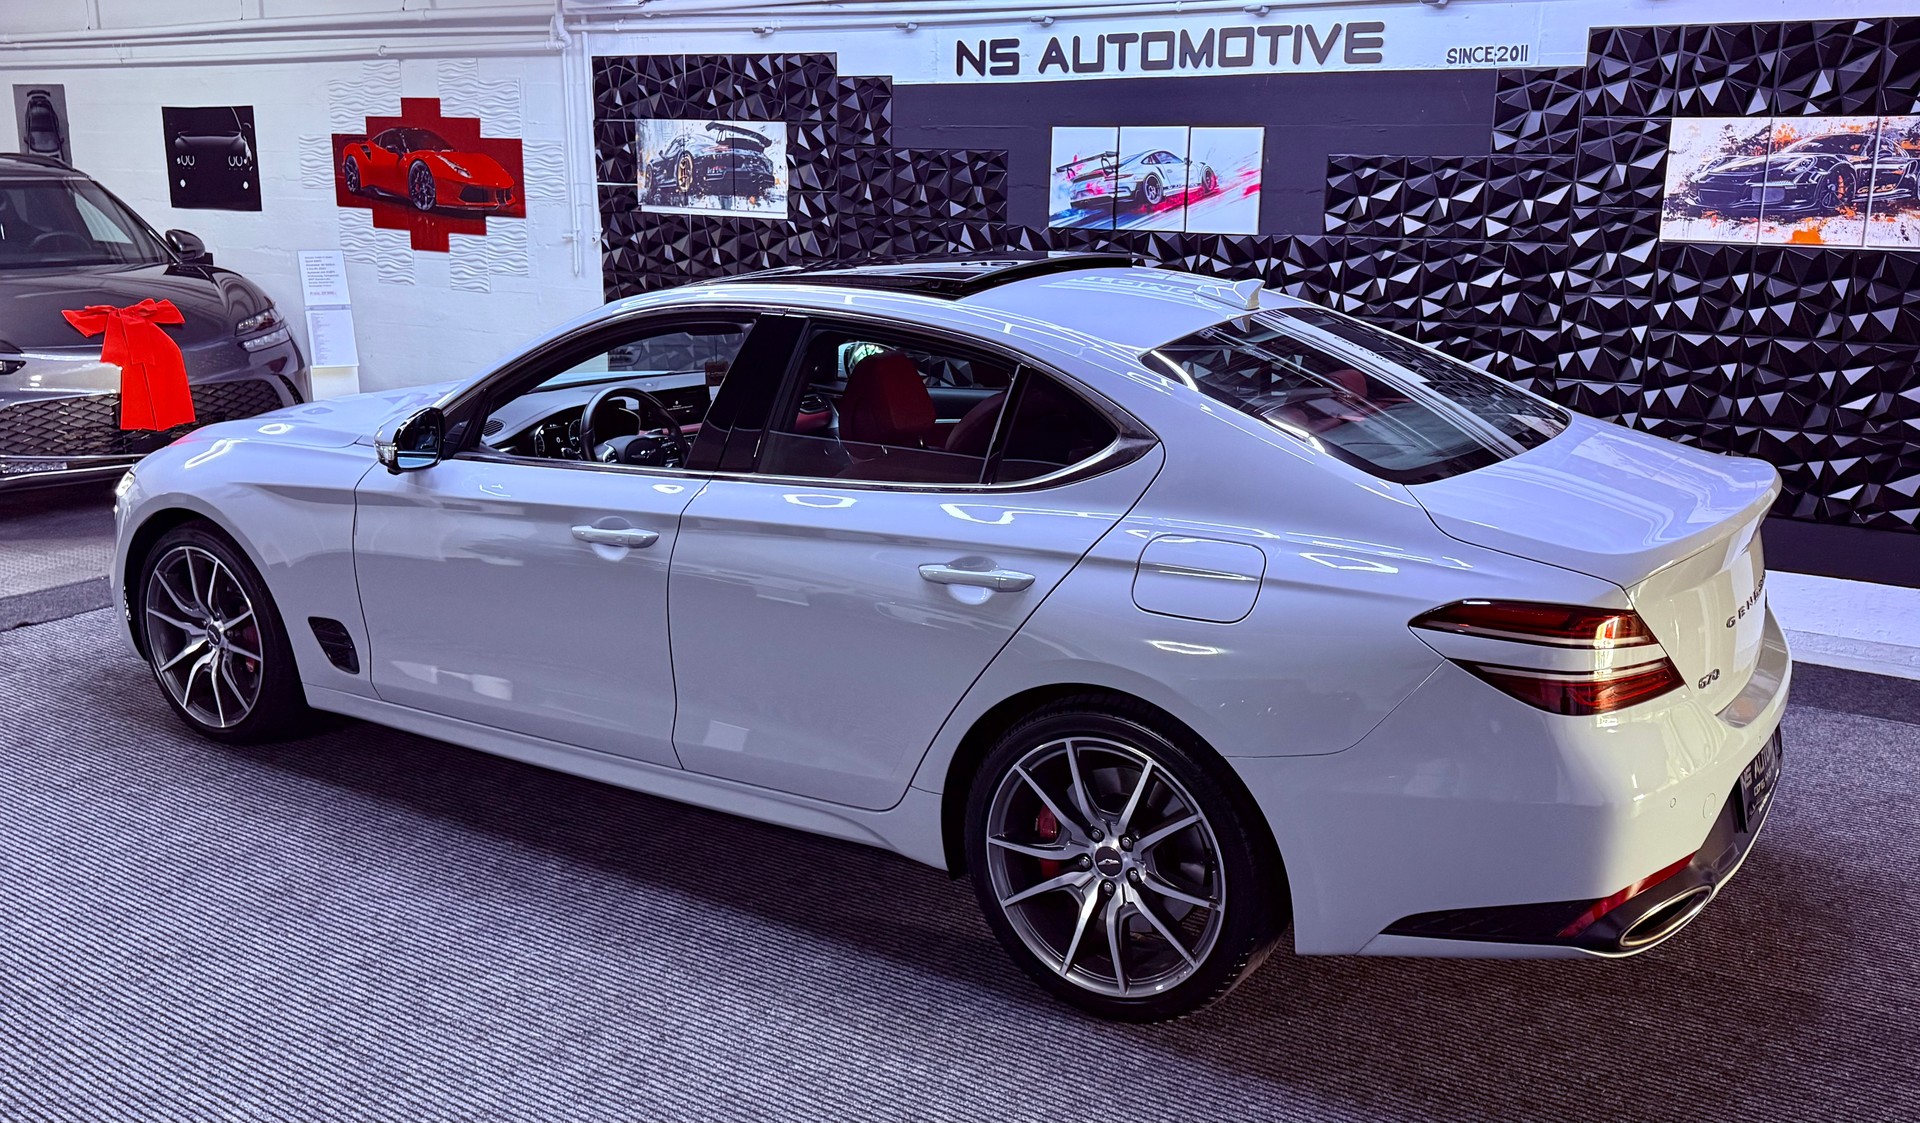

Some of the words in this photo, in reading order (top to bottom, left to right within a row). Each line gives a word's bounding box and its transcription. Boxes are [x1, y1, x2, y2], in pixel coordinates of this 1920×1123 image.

[956, 39, 1020, 77] NS
[1038, 21, 1385, 74] AUTOMOTIVE
[1446, 46, 1494, 64] SINCE
[1496, 45, 1528, 62] 2011
[1726, 570, 1766, 628] GENES
[1698, 668, 1720, 689] G70
